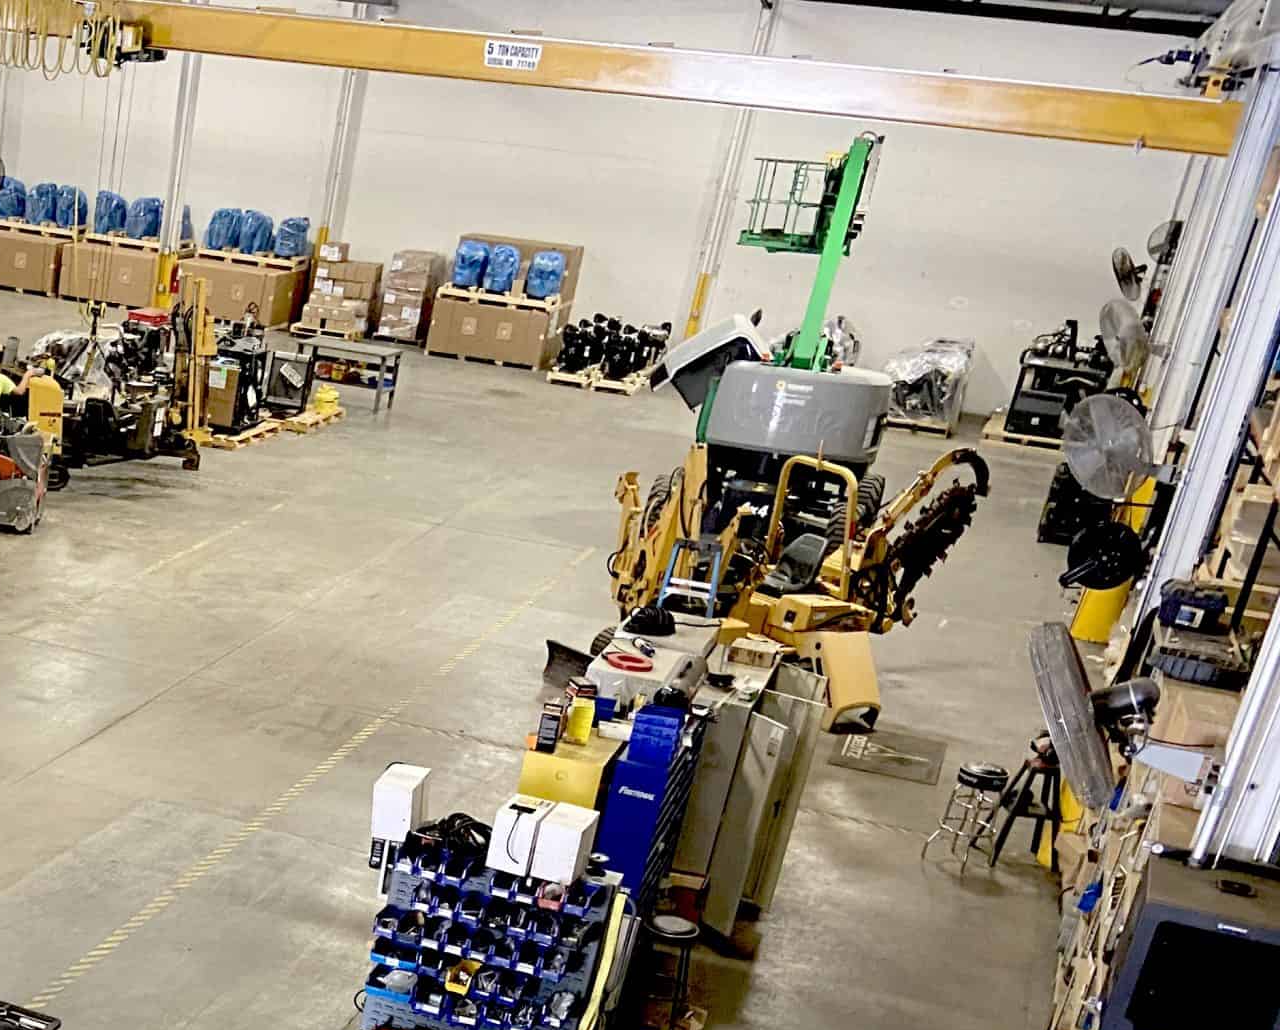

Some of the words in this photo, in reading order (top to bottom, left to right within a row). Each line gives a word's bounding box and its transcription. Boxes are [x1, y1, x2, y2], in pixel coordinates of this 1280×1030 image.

[487, 42, 495, 55] 5
[498, 44, 509, 56] TON
[510, 45, 540, 59] CAPACITY
